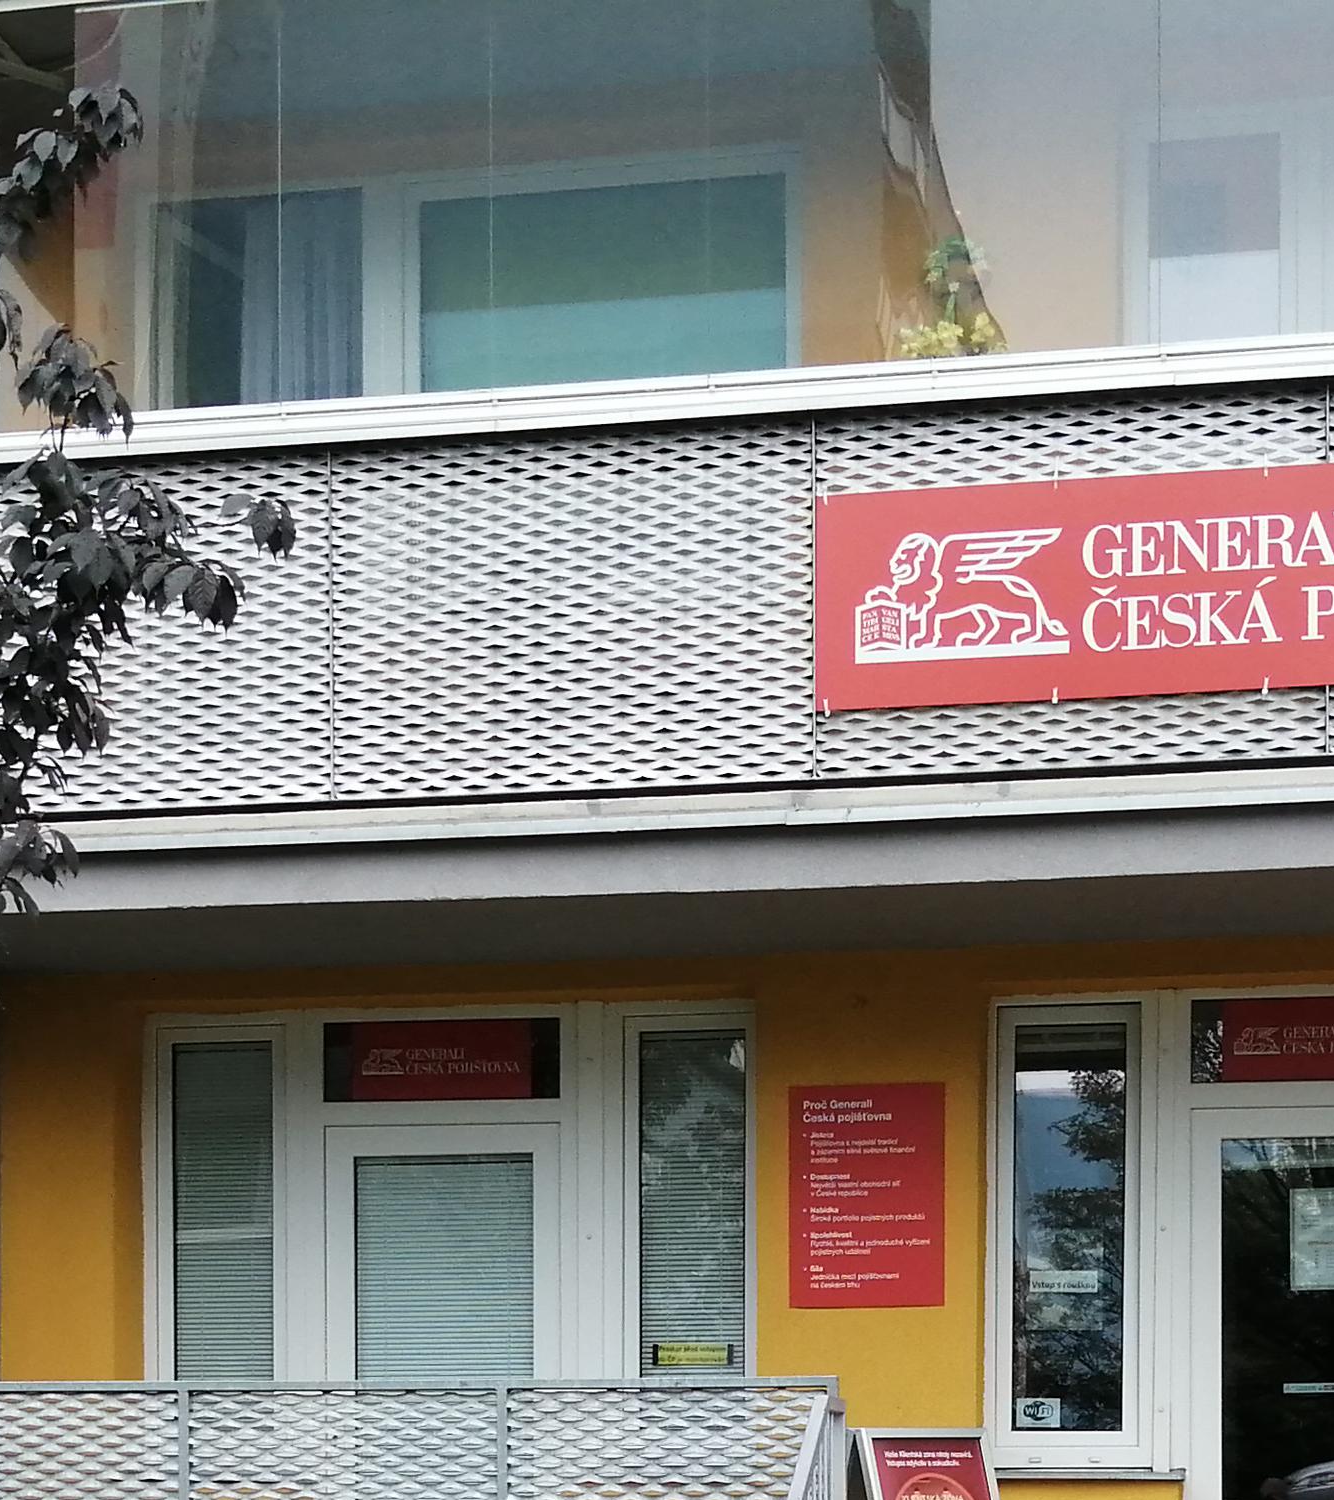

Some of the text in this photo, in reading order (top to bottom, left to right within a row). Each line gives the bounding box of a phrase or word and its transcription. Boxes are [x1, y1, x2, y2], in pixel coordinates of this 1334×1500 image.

[1081, 575, 1282, 653] ČESKÁ
[1282, 1038, 1326, 1054] ČESKÁ
[405, 1047, 465, 1060] GENERALI
[405, 1058, 521, 1075] ČESKÁ POJIŠŤOVNA
[803, 1099, 873, 1110] Proč Generali
[803, 1111, 892, 1124] Česká pojišťovna
[1031, 1280, 1056, 1290] Vstup
